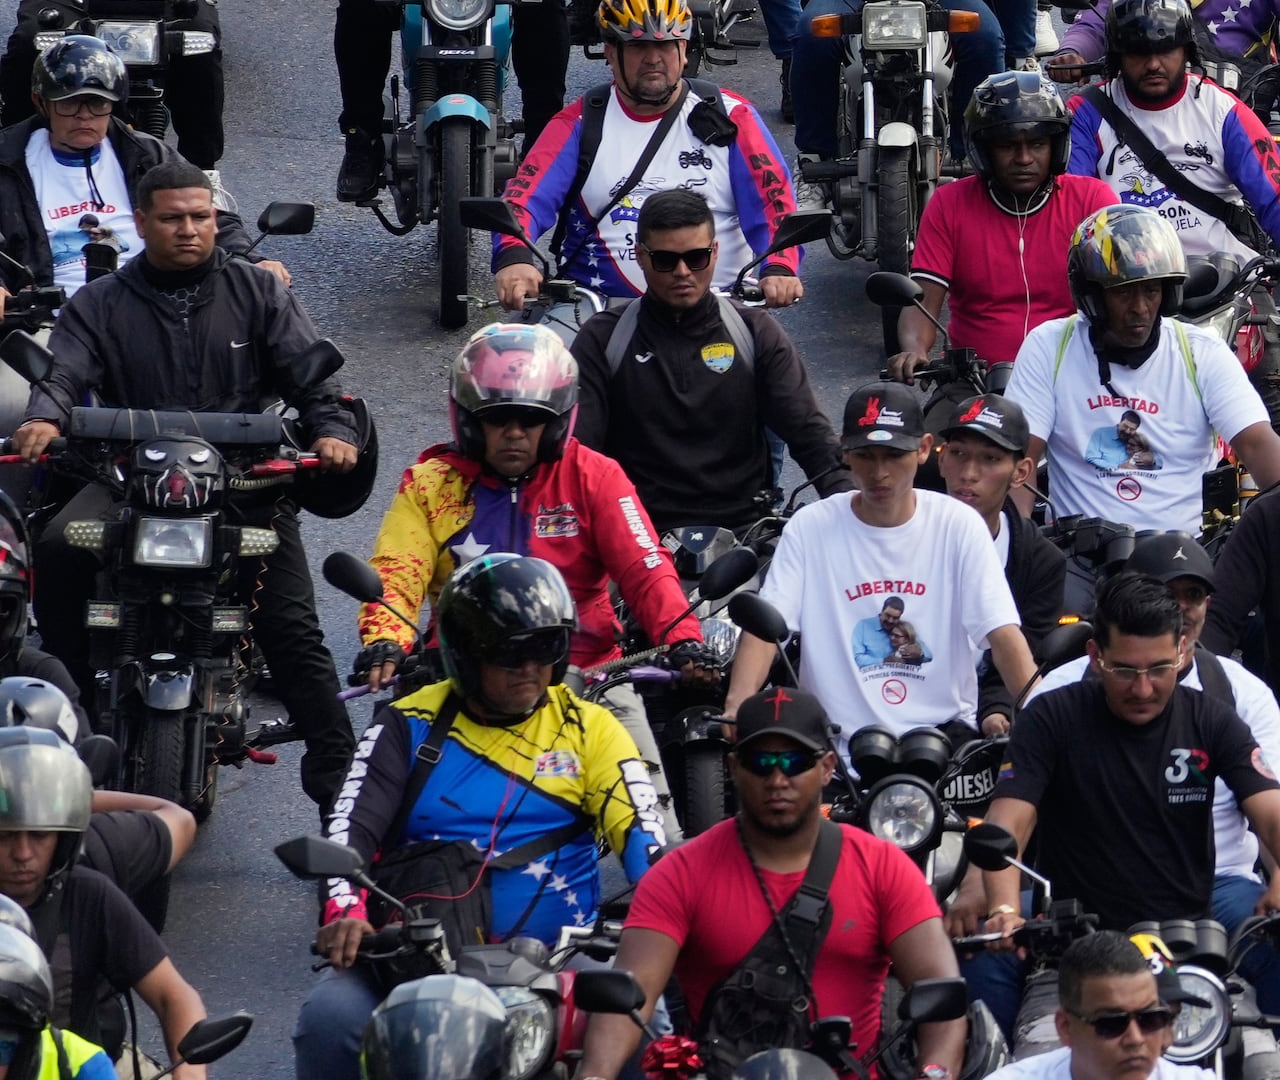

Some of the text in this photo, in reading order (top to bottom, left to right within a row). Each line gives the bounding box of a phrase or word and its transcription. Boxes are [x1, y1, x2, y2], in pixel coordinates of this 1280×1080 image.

[1087, 395, 1160, 416] LIBERTAD
[846, 580, 927, 602] LIBERTAD
[944, 768, 996, 801] DIESEL
[1167, 795, 1184, 804] TRES
